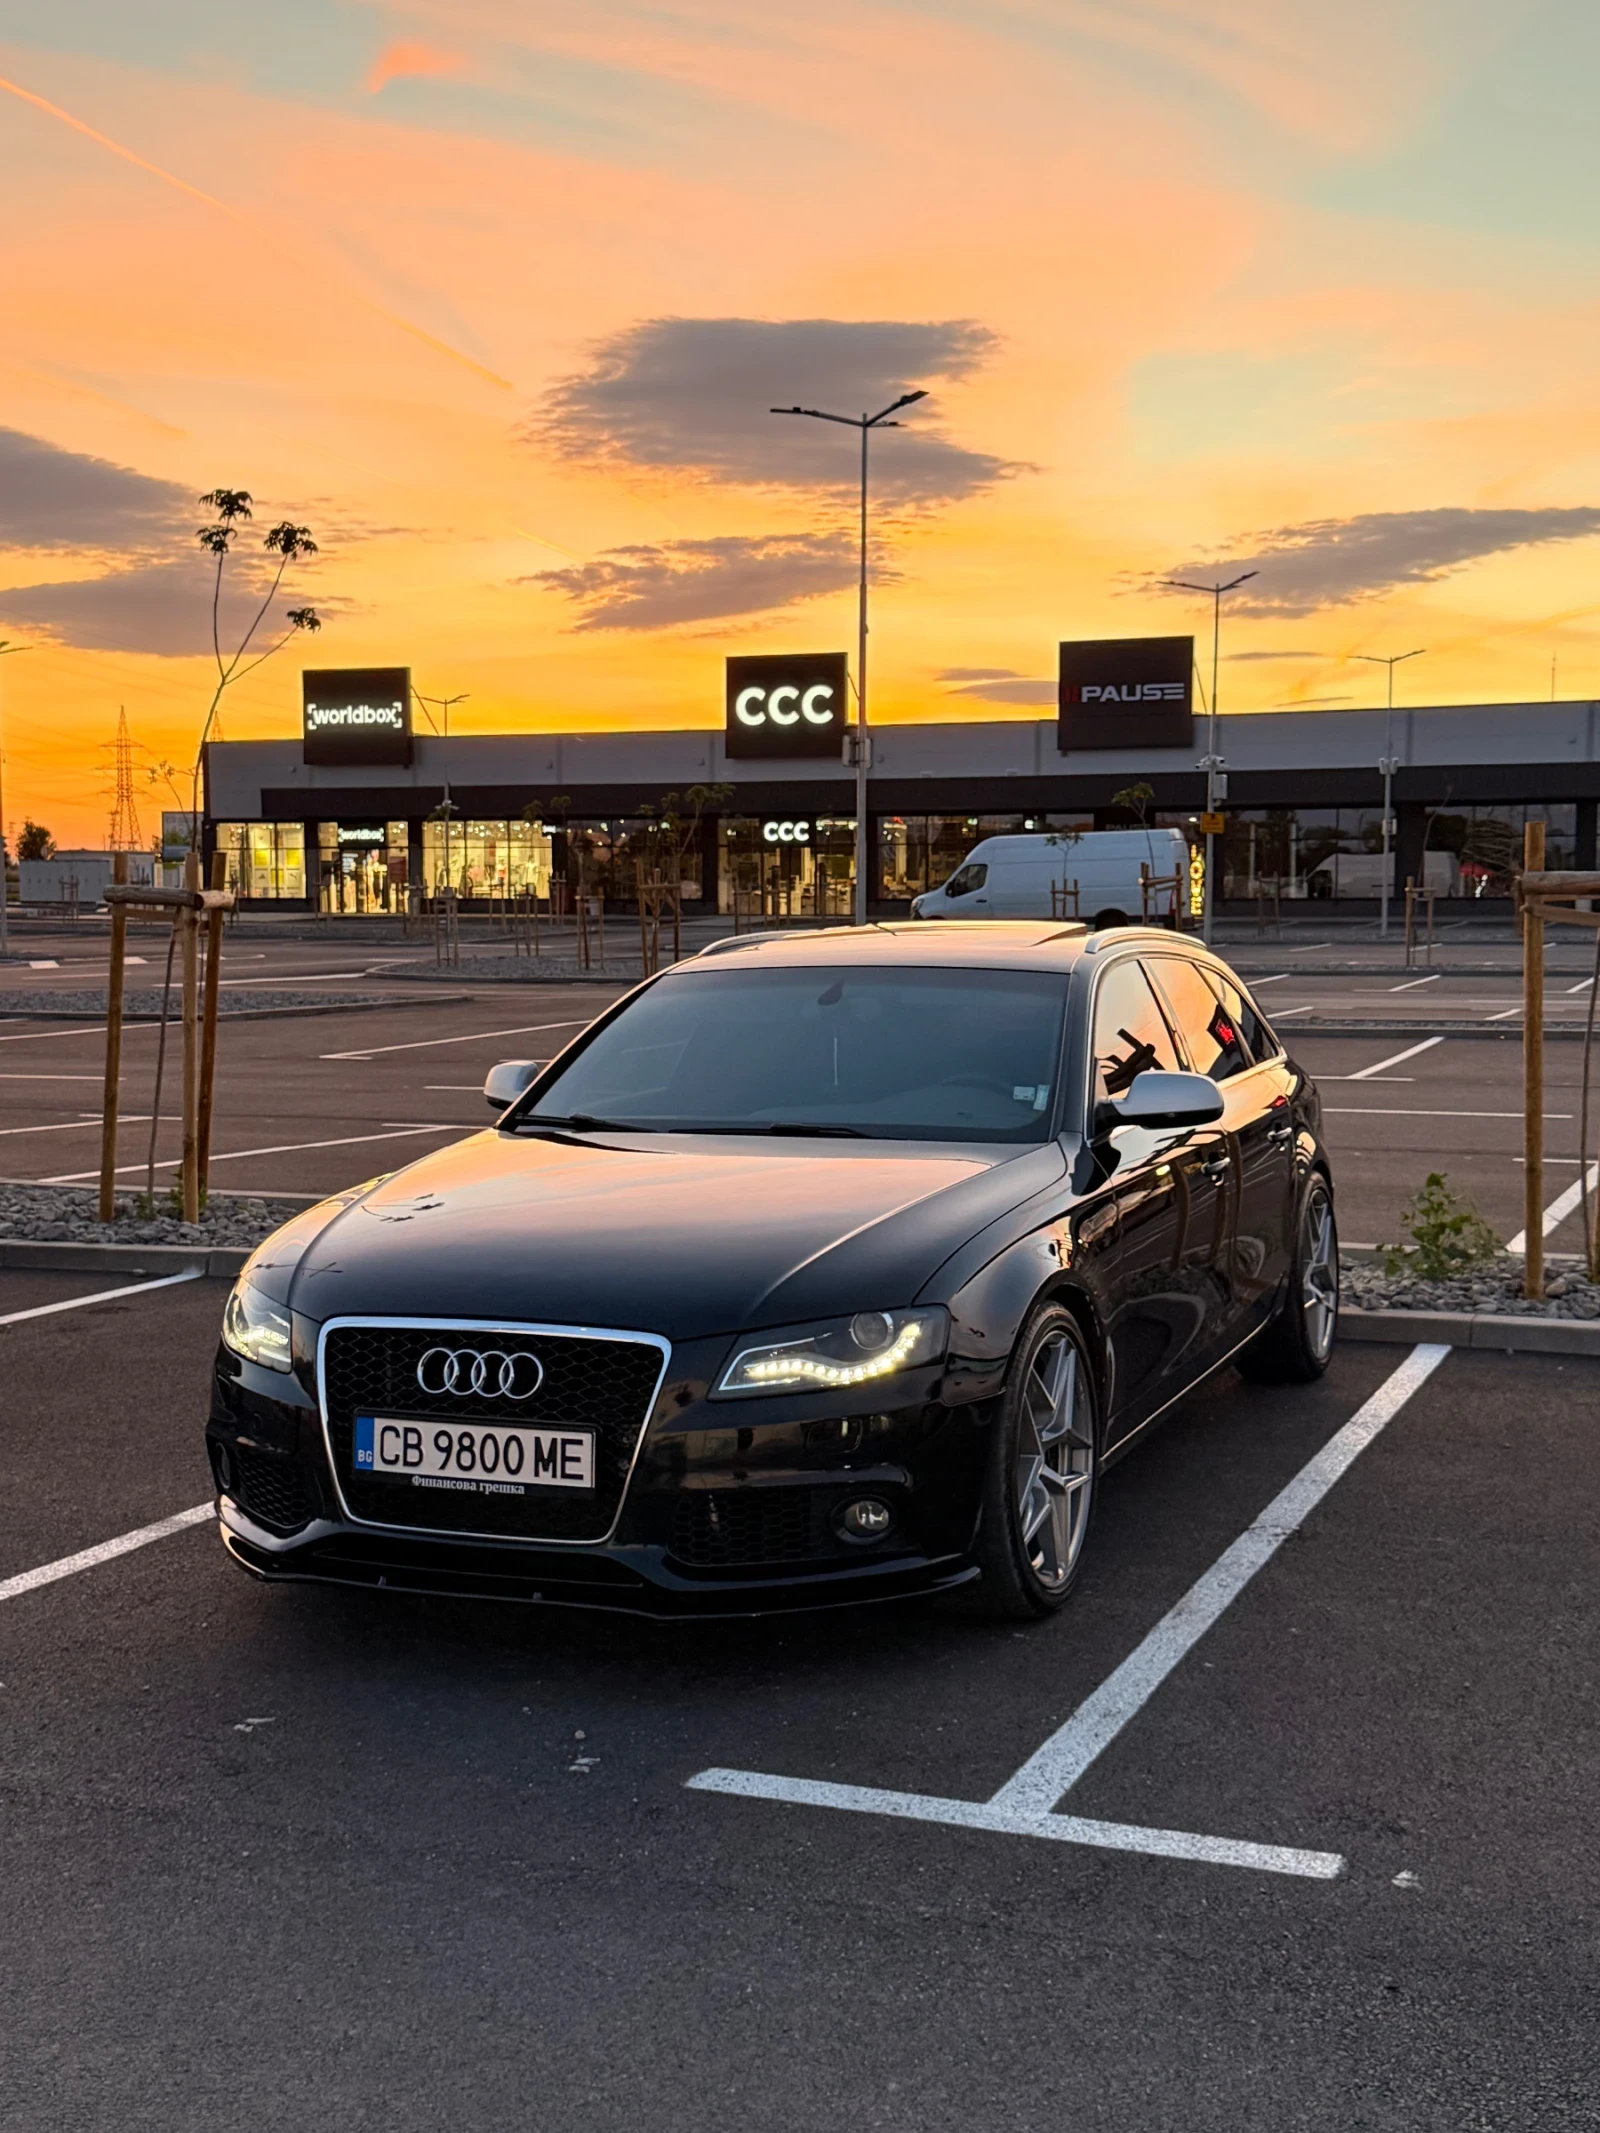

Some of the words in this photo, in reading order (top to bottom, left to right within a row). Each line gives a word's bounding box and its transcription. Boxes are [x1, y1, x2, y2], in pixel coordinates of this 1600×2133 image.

[1081, 683, 1184, 703] PAUSE
[311, 703, 398, 725] worldbox
[736, 684, 834, 726] CCC
[763, 821, 810, 842] CCC
[357, 1449, 373, 1463] BG
[380, 1425, 424, 1467] CB
[433, 1430, 525, 1476] 9800
[533, 1436, 585, 1480] ME
[411, 1475, 477, 1490] Финансова
[478, 1482, 525, 1495] грешка
